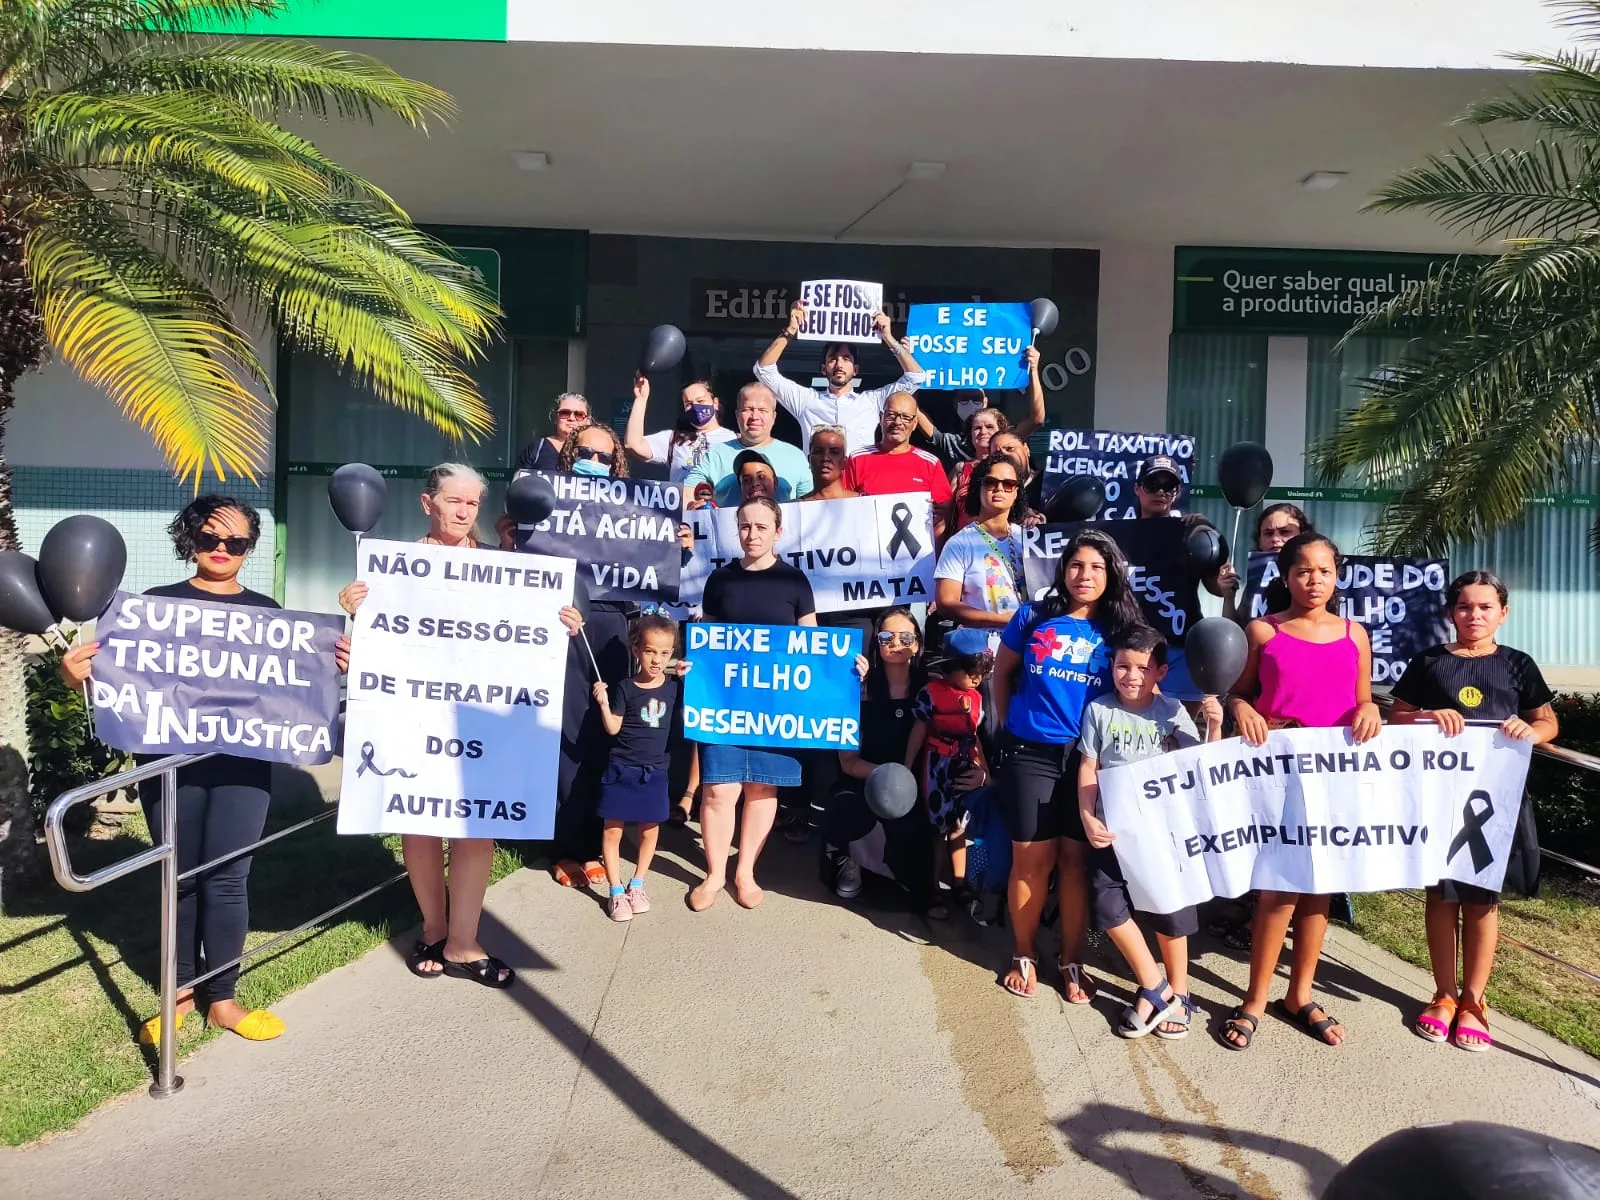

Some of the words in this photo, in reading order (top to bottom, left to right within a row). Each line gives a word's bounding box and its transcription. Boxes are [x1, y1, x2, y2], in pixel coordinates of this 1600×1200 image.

[813, 284, 831, 307] SE
[1223, 269, 1277, 293] Quer
[1283, 270, 1342, 291] saber
[1348, 272, 1395, 298] qual
[706, 287, 790, 319] Edifí
[938, 307, 950, 324] E
[963, 308, 987, 326] SE
[1222, 297, 1235, 312] a
[909, 335, 968, 354] FOSSE
[982, 336, 1021, 354] SEU
[1049, 430, 1090, 453] ROL
[633, 481, 680, 511] NÃO
[518, 503, 587, 536] STÁ
[368, 553, 431, 578] NÃO
[444, 561, 563, 590] LIMITEM
[1336, 556, 1394, 590] ÚDE
[1402, 563, 1445, 592] DO
[842, 576, 927, 602] MATA
[370, 613, 410, 635] AS
[417, 617, 549, 646] SESSÕES
[787, 629, 851, 657] MEU
[1030, 663, 1043, 675] DE
[1049, 666, 1102, 687] AUTISTA
[93, 680, 142, 714] DA
[359, 672, 396, 695] DE
[406, 678, 550, 708] TERAPIAS
[684, 704, 860, 746] DESENVOLVER
[425, 735, 484, 759] DOS
[1143, 769, 1197, 800] STJ
[1208, 751, 1382, 786] MANTENHA
[1389, 749, 1412, 770] O
[1422, 749, 1476, 772] ROL
[386, 794, 527, 821] AUTISTAS
